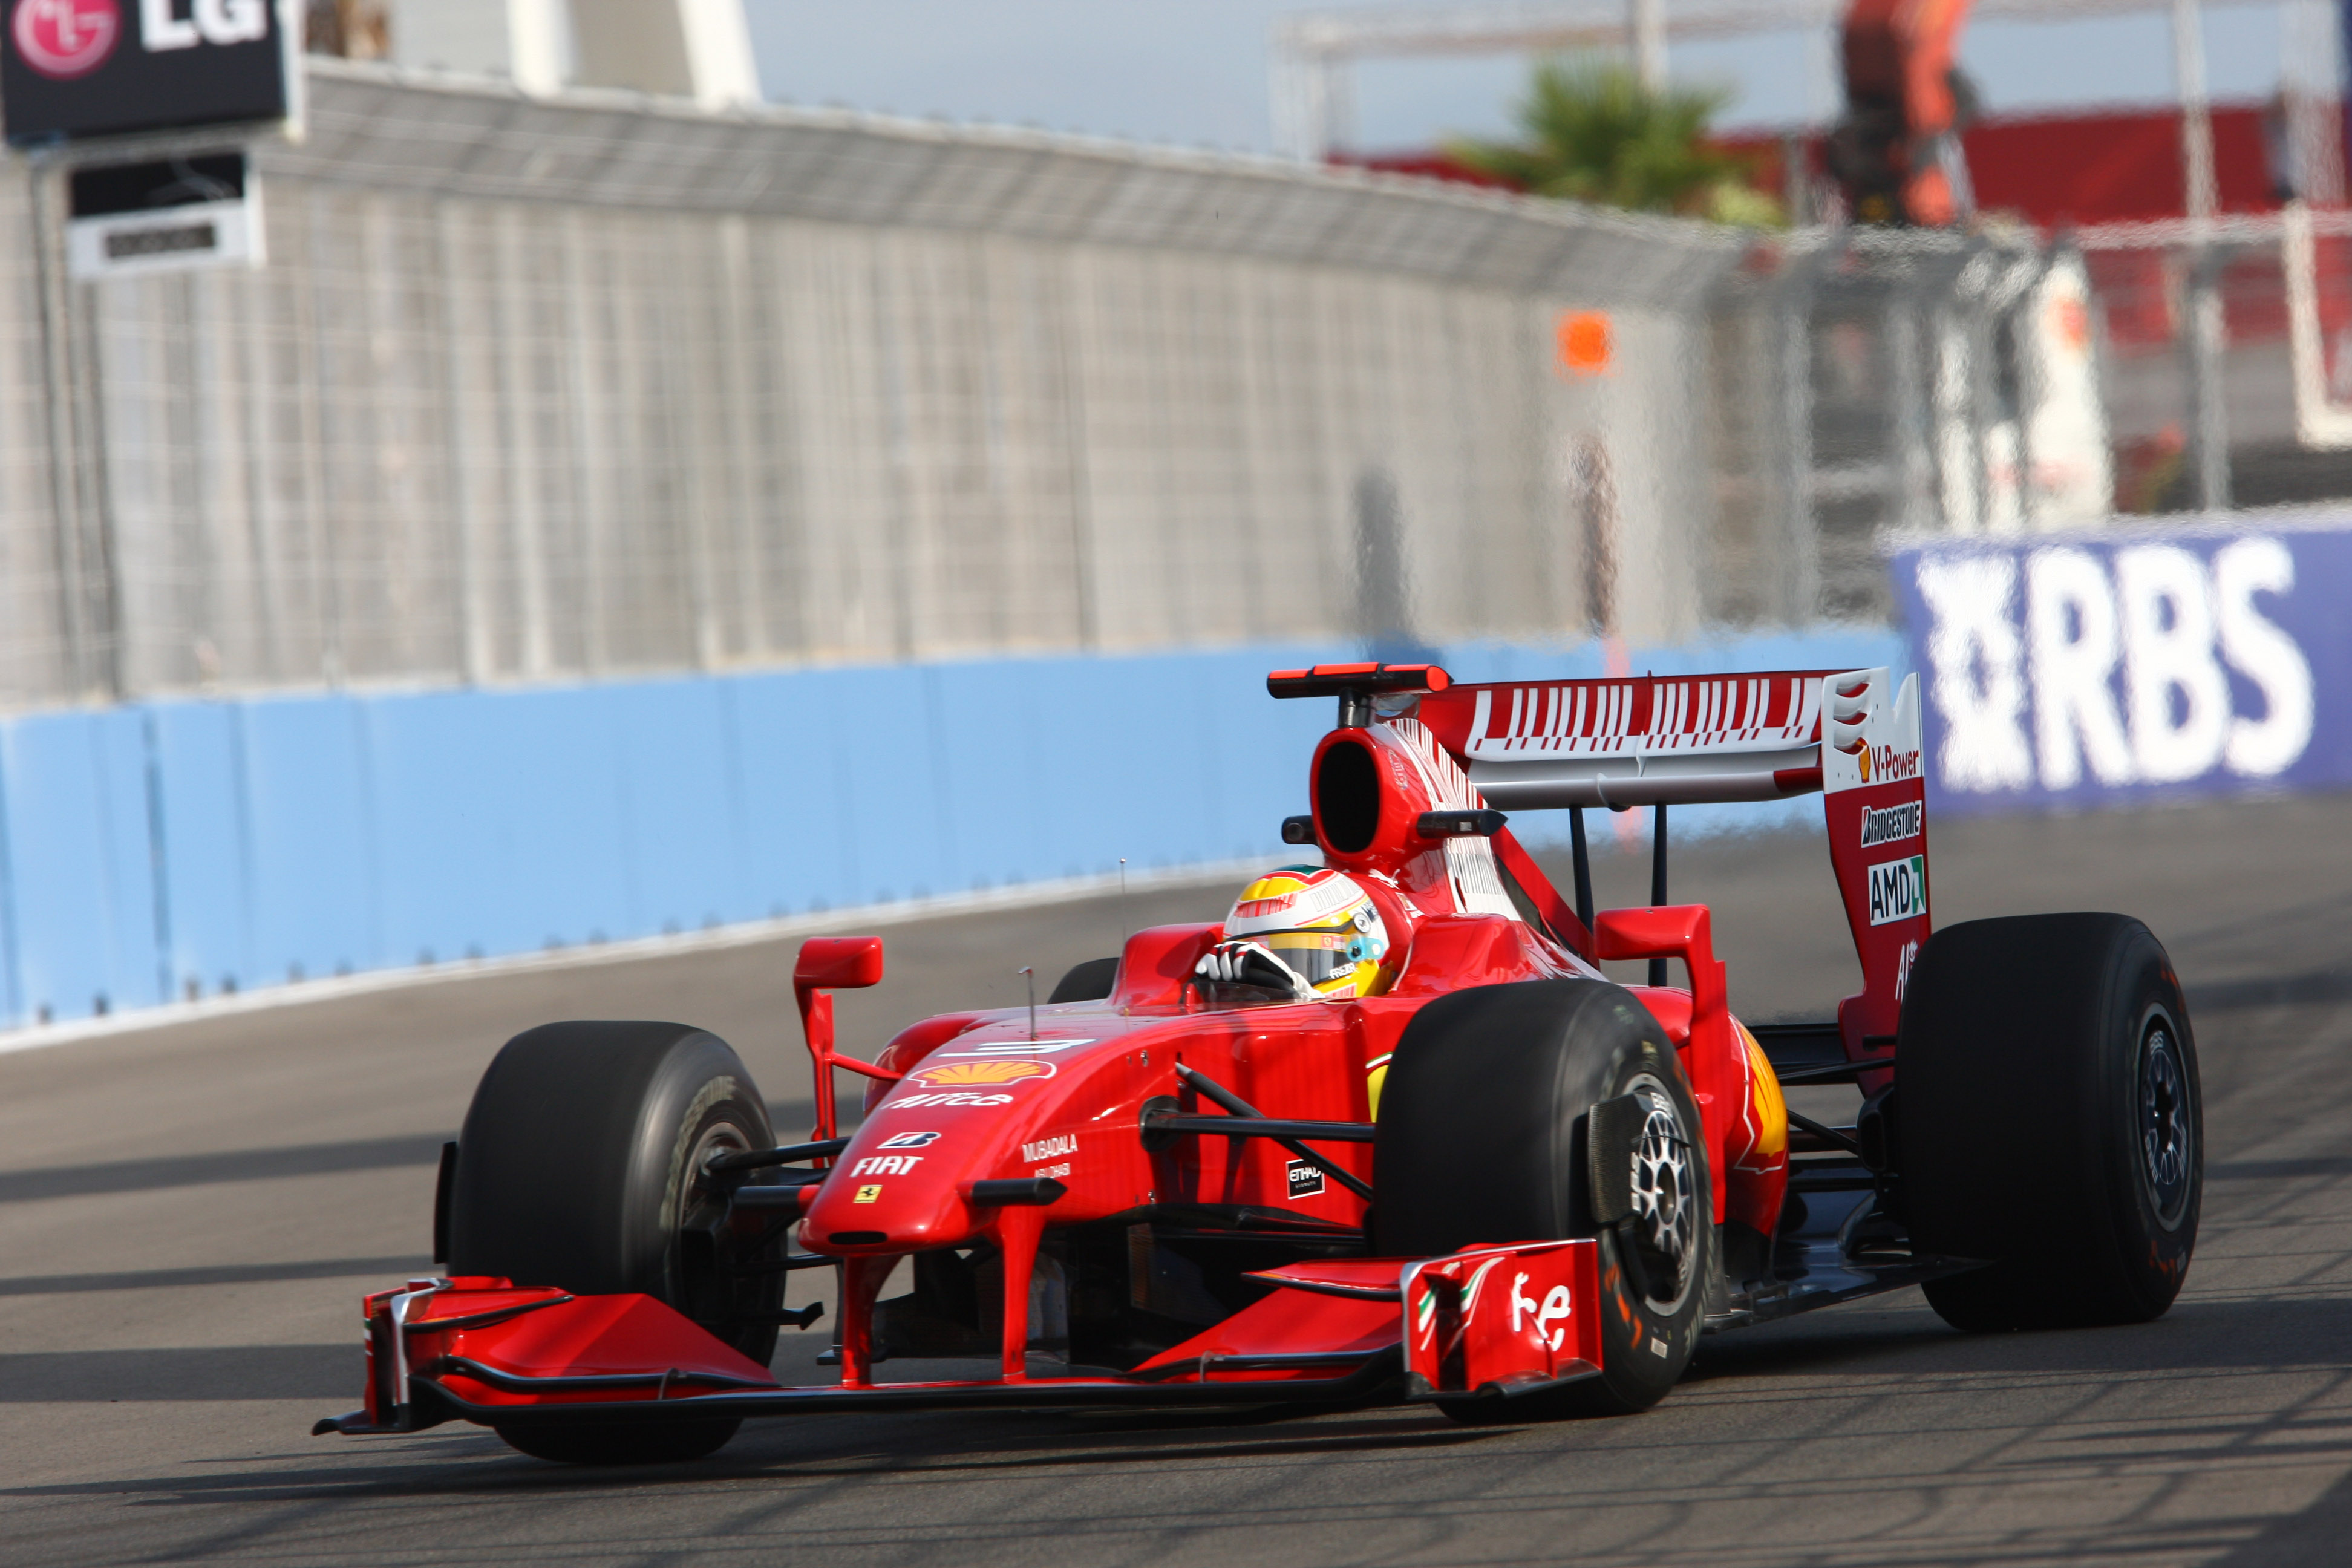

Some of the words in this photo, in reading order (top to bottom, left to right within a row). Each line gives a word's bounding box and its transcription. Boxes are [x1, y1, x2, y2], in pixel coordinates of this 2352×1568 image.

[139, 0, 268, 52] LG
[2024, 537, 2314, 790] RBS
[1872, 745, 1919, 782] V-Power
[1861, 803, 1921, 846] BRIDGESTONE
[1870, 864, 1910, 921] AMD
[849, 1155, 924, 1178] FIAT
[1022, 1134, 1078, 1163] MUBADALA
